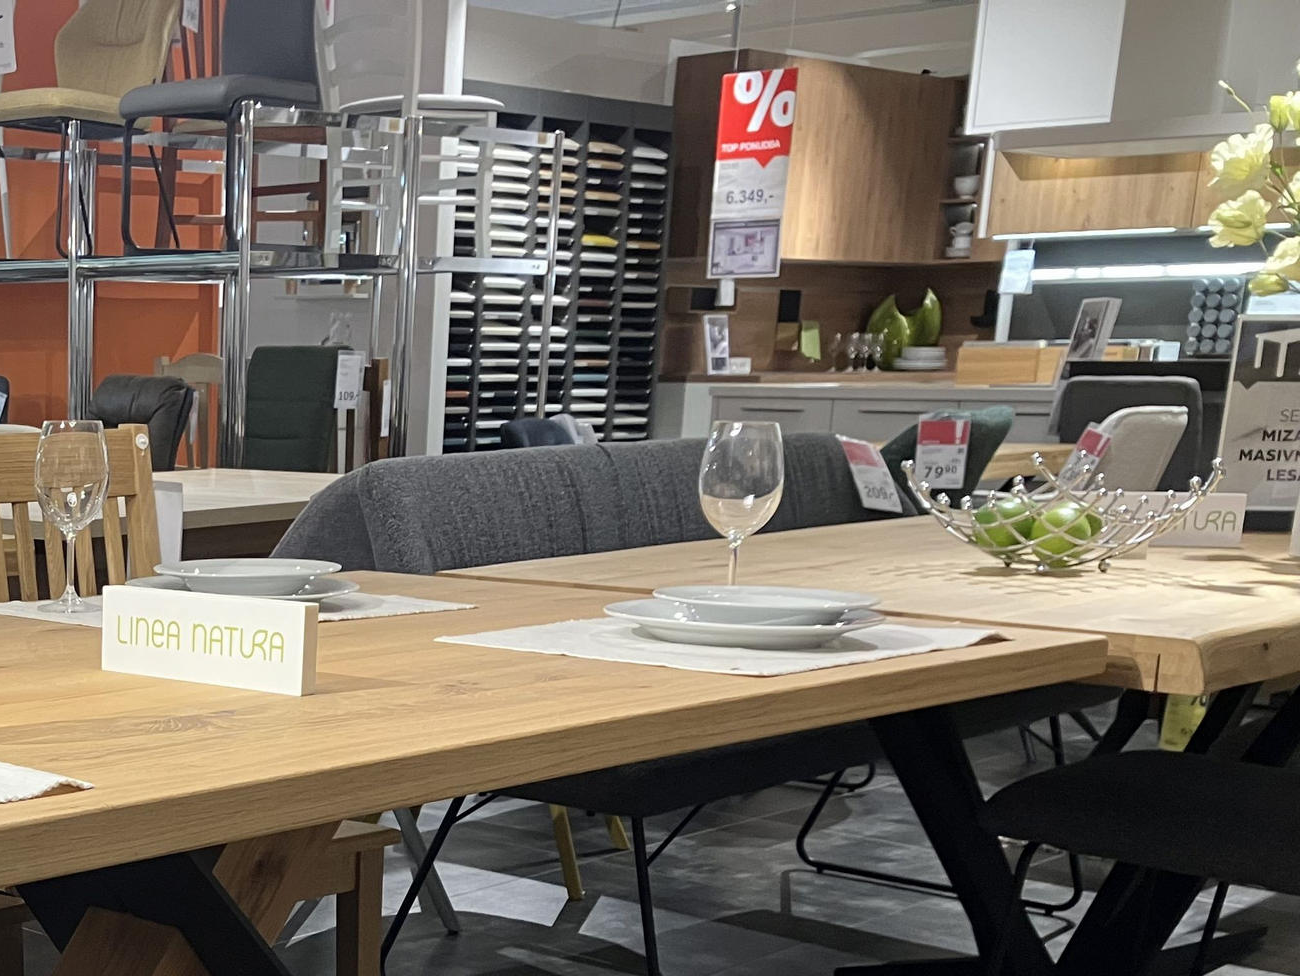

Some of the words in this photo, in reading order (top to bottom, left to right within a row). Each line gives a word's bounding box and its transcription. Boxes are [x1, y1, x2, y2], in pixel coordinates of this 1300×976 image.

[726, 189, 775, 205] 6.349,-
[1267, 468, 1300, 482] LES
[192, 623, 285, 664] NATURA
